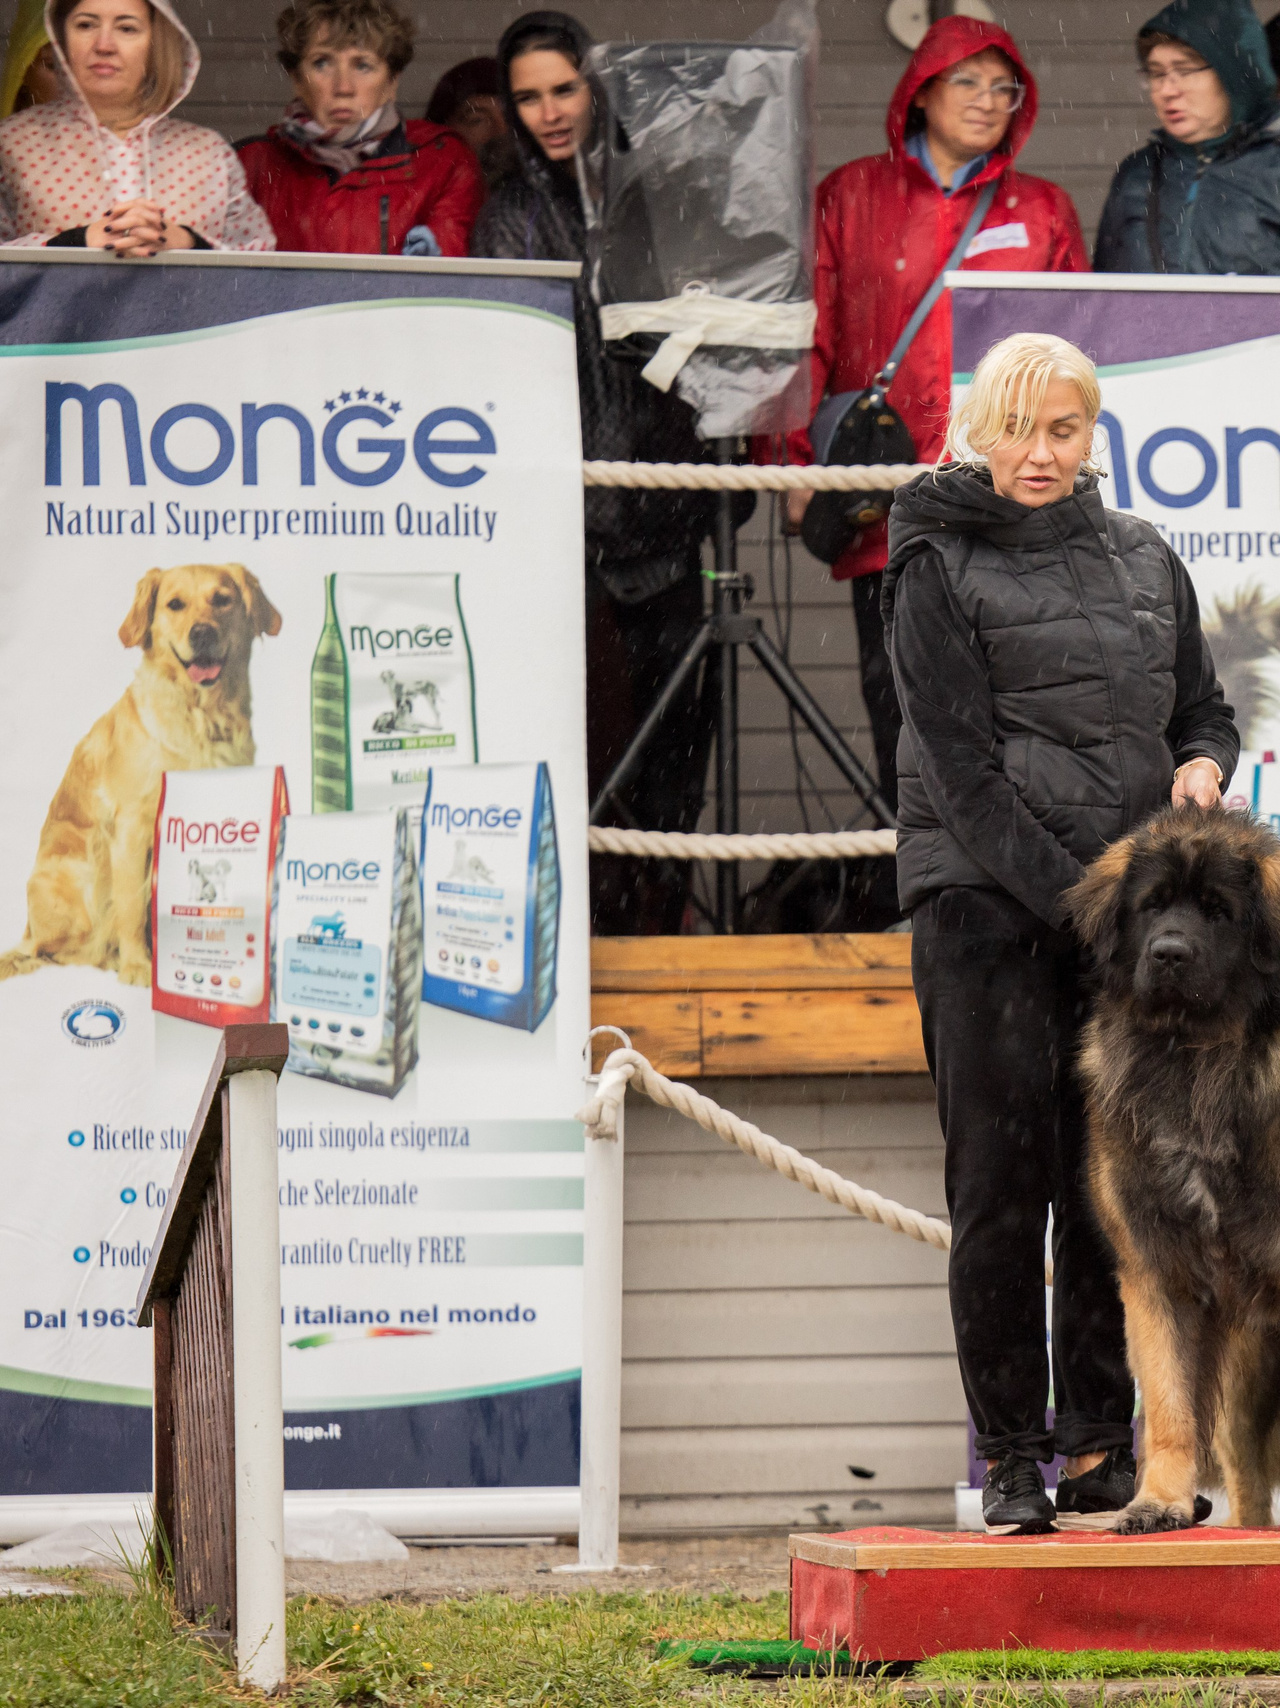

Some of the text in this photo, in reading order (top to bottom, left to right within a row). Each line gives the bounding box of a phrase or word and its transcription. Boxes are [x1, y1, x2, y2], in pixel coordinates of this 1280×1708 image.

[45, 501, 498, 543] Natural Superpremium Quality
[93, 1124, 155, 1151] Ricette
[319, 1121, 385, 1152] singola
[390, 1121, 470, 1152] esigenza
[278, 1179, 308, 1207] che
[313, 1179, 419, 1206] Selezionate
[99, 1235, 466, 1269] Prodo rantito Cruelty FREE
[24, 1308, 66, 1329] Dal
[294, 1305, 390, 1325] italiano
[400, 1304, 438, 1324] nel
[448, 1303, 537, 1324] mondo
[282, 1422, 342, 1443] onge.it
